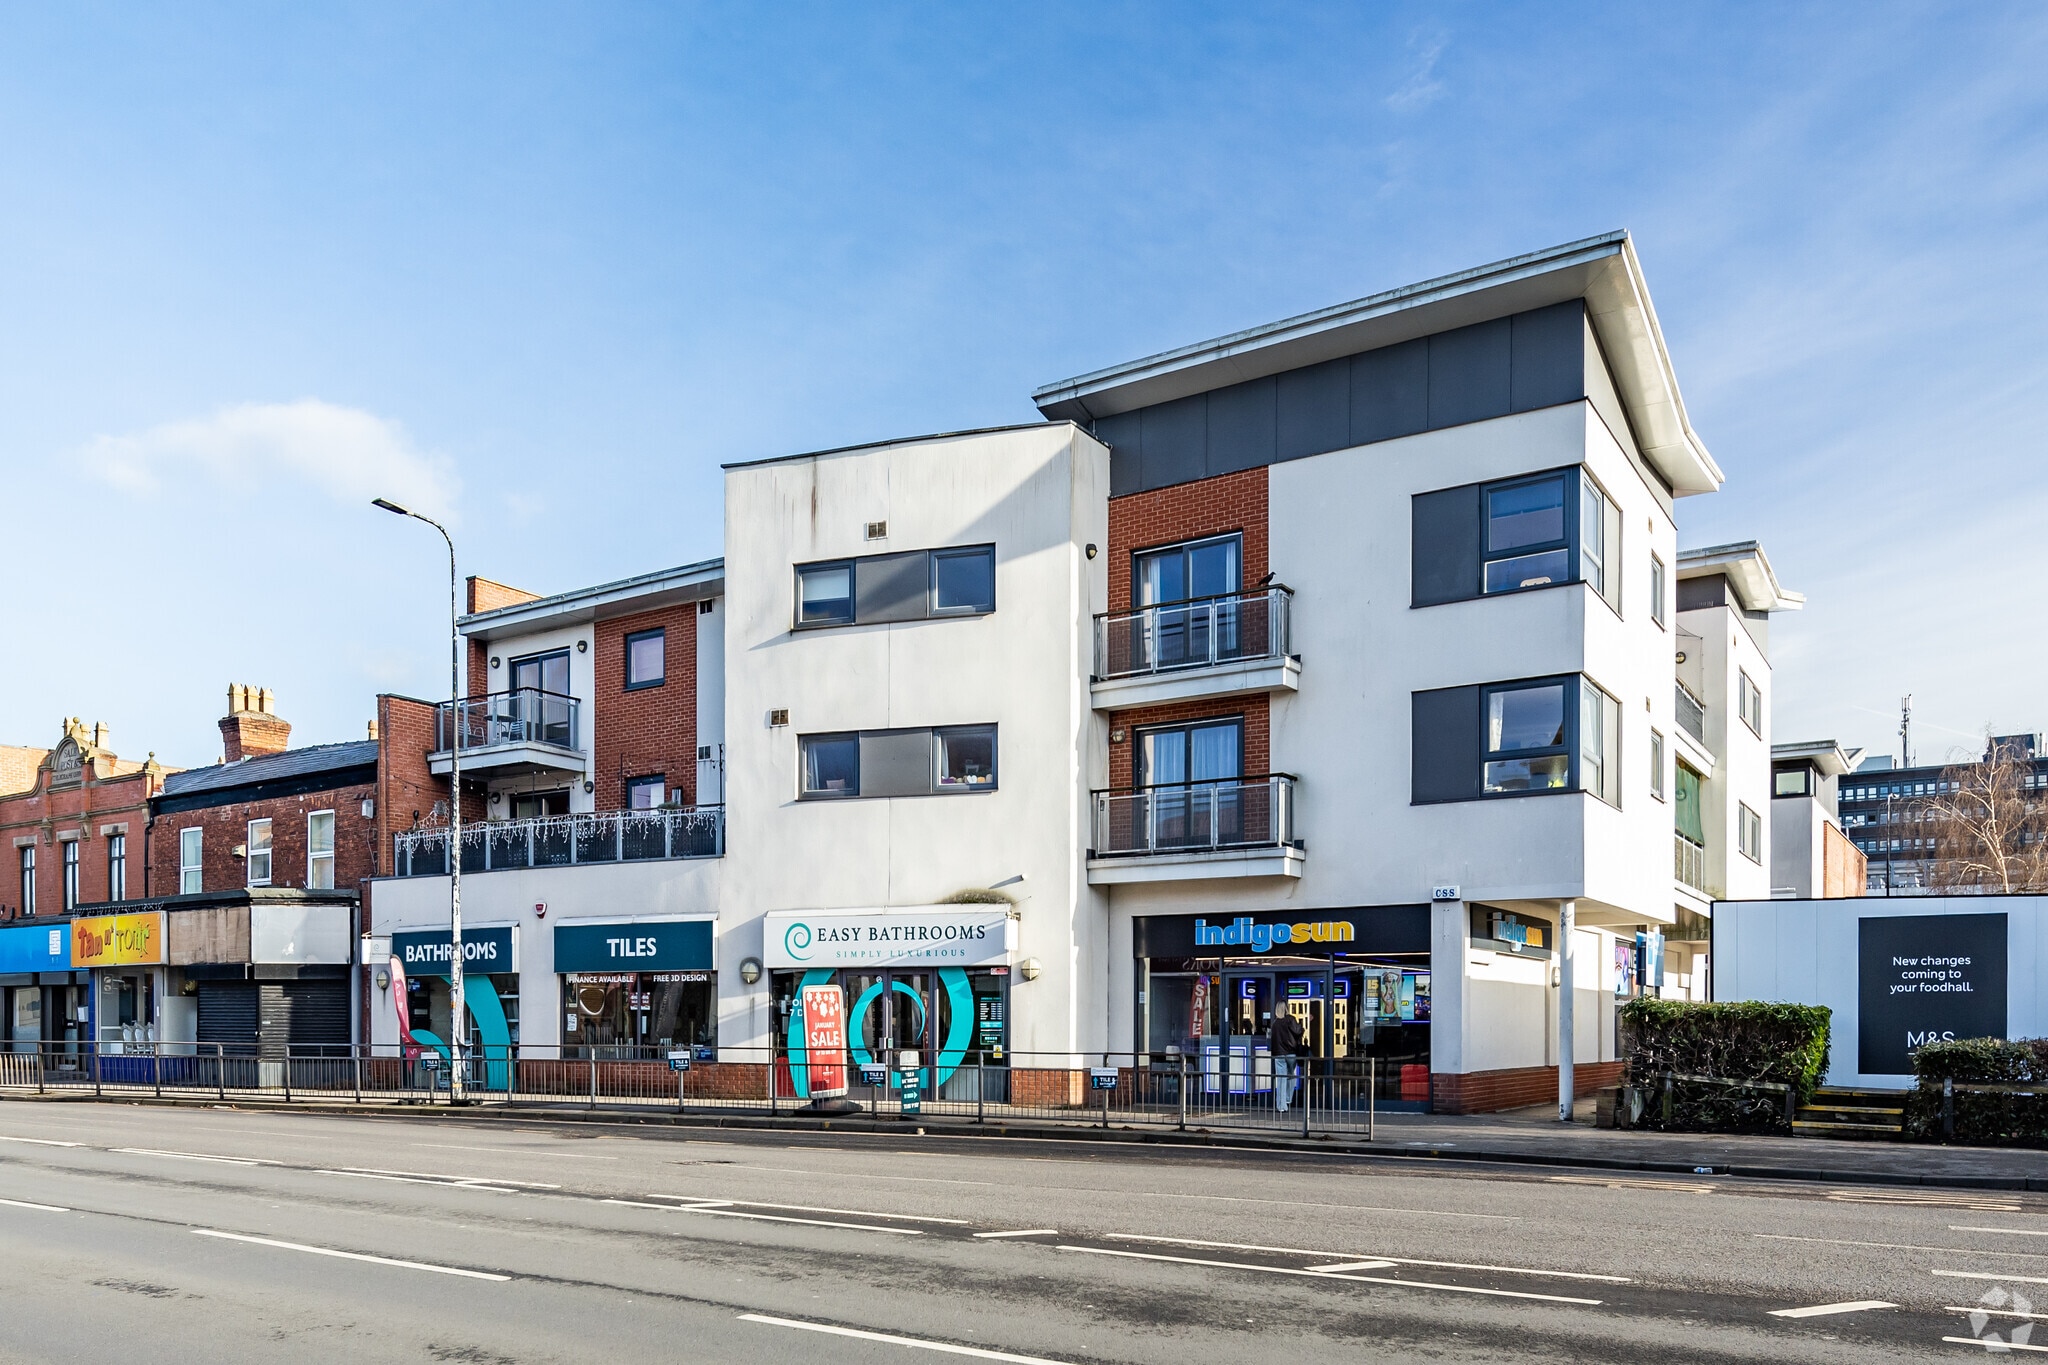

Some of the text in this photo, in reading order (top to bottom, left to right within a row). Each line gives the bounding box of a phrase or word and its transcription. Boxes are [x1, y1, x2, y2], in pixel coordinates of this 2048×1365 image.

[817, 925, 986, 942] EASY BATHROOMS
[1195, 917, 1355, 953] indigosun
[405, 941, 497, 963] BATHROMS
[606, 937, 657, 957] TILES
[836, 949, 966, 958] SIMPLY LUXURIOUS
[1892, 955, 1972, 968] New changes
[568, 975, 635, 984] FINANCE AVAILABLE
[653, 974, 707, 982] FREE 3D DESIGN
[1901, 968, 1962, 981] coming to
[1889, 982, 1974, 995] your foodhall.
[1192, 984, 1205, 1035] SALE
[811, 1030, 840, 1048] SALE
[1907, 1030, 1955, 1048] M&S
